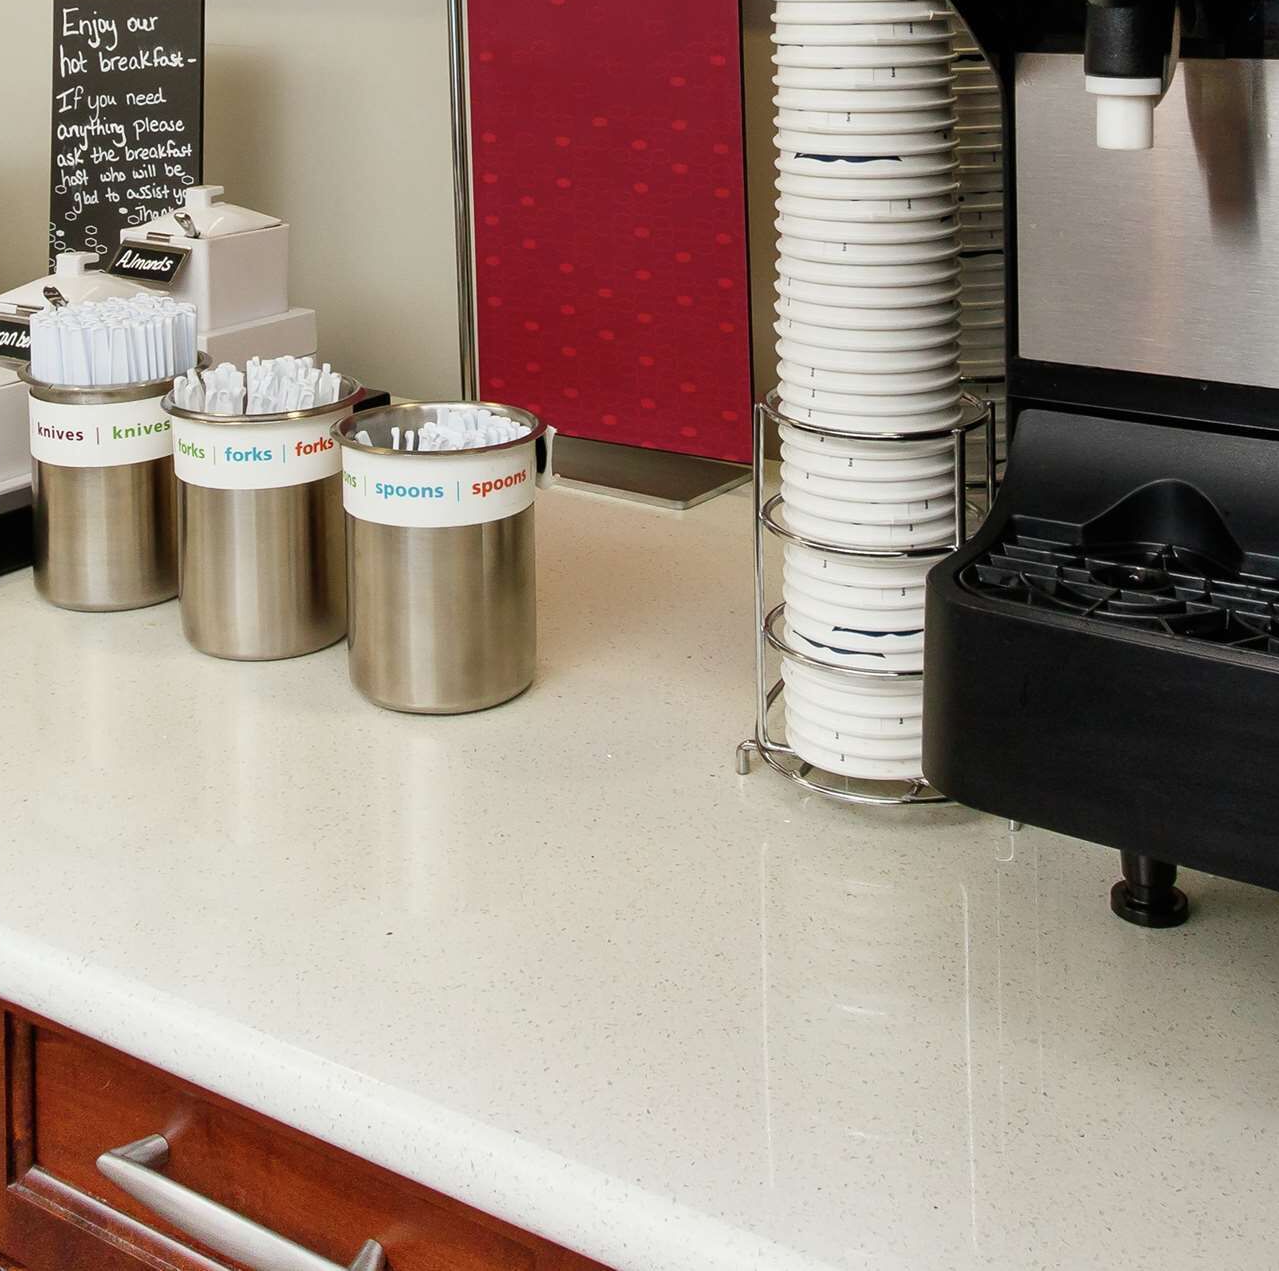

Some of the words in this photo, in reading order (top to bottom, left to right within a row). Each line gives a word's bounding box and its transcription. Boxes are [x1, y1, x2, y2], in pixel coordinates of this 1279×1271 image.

[63, 8, 118, 51] Enjoy
[127, 16, 158, 32] our
[60, 44, 88, 78] hot
[56, 85, 84, 113] If
[88, 94, 117, 121] you
[126, 87, 167, 106] need
[57, 117, 127, 151] anything
[133, 117, 185, 140] please
[57, 146, 84, 167] ask
[90, 146, 120, 164] the
[125, 139, 192, 161] breakfast
[61, 169, 89, 187] host
[100, 167, 126, 182] who
[133, 163, 156, 179] will
[164, 163, 186, 177] be
[72, 189, 99, 214] glad
[105, 187, 120, 203] to
[126, 183, 170, 199] assist
[115, 249, 173, 271] Almonds
[37, 421, 84, 441] knives
[113, 419, 170, 440] knives
[178, 438, 205, 459] forks
[225, 447, 272, 462] forks
[295, 437, 334, 457] forks
[375, 481, 444, 499] spoons
[472, 469, 527, 498] spoons
